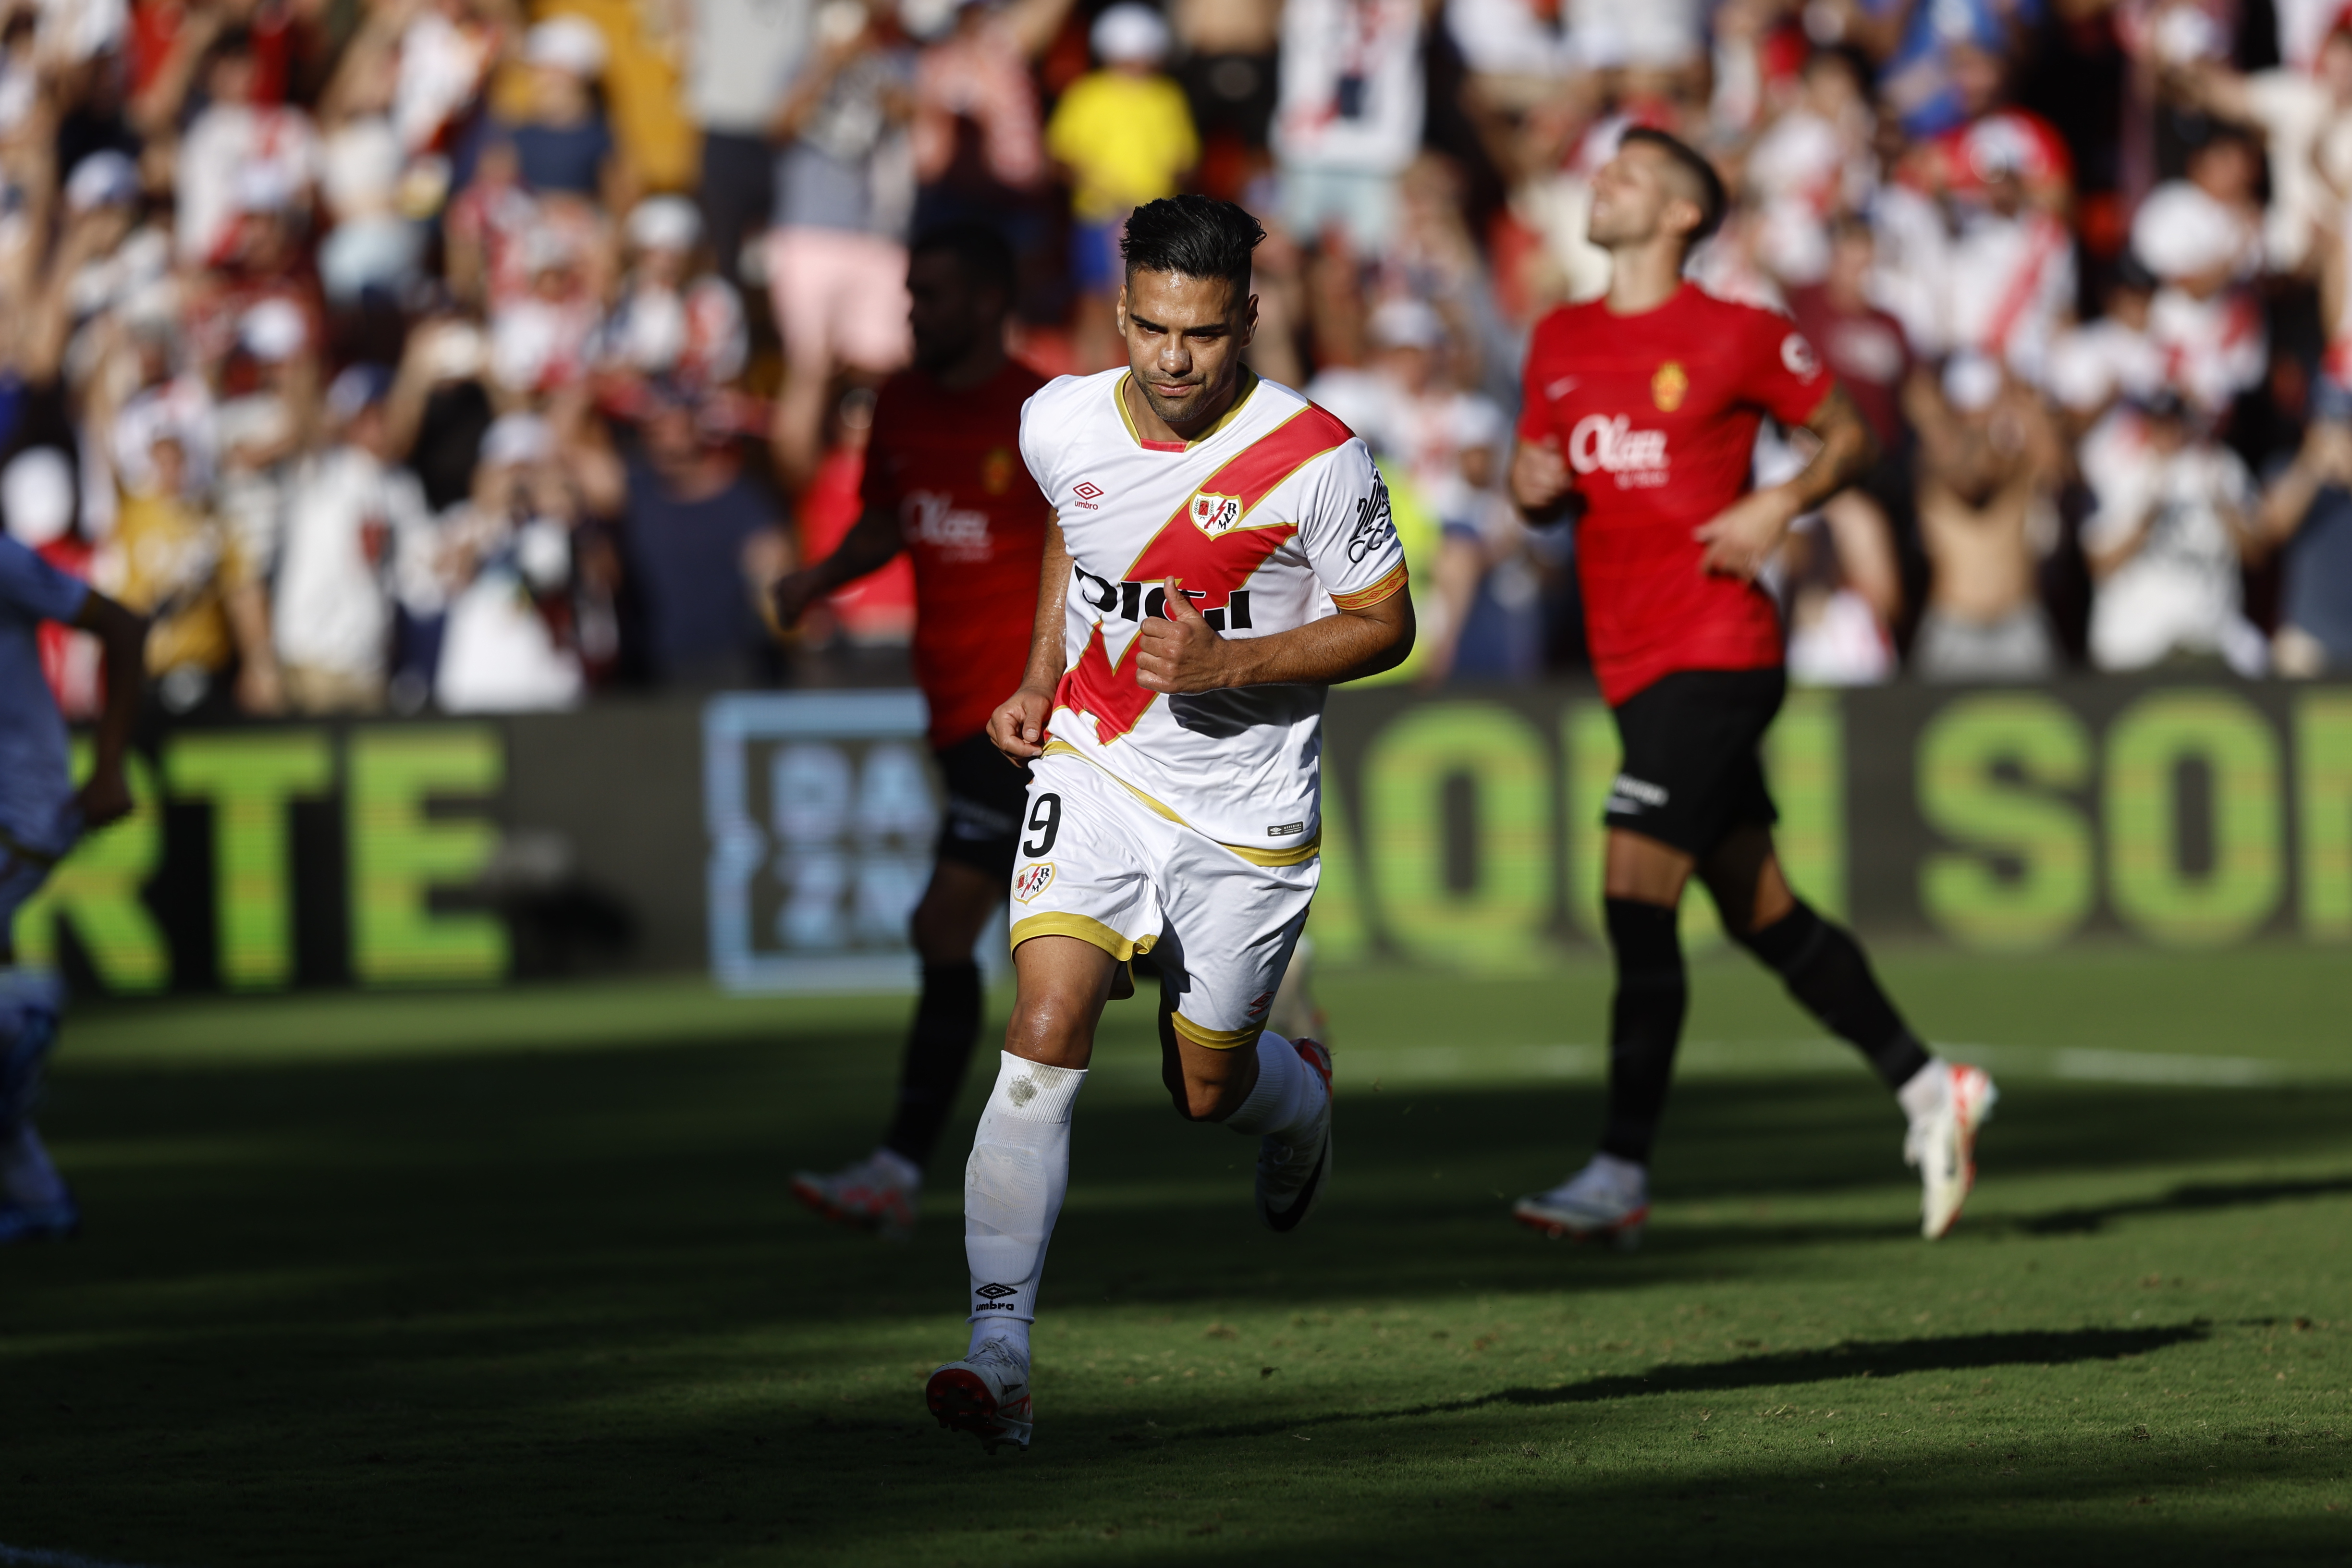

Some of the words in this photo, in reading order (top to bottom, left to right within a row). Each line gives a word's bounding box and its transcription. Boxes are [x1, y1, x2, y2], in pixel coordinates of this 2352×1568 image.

[1075, 500, 1098, 510] umbro
[1023, 793, 1061, 858] 9
[976, 1300, 1015, 1311] umbro
